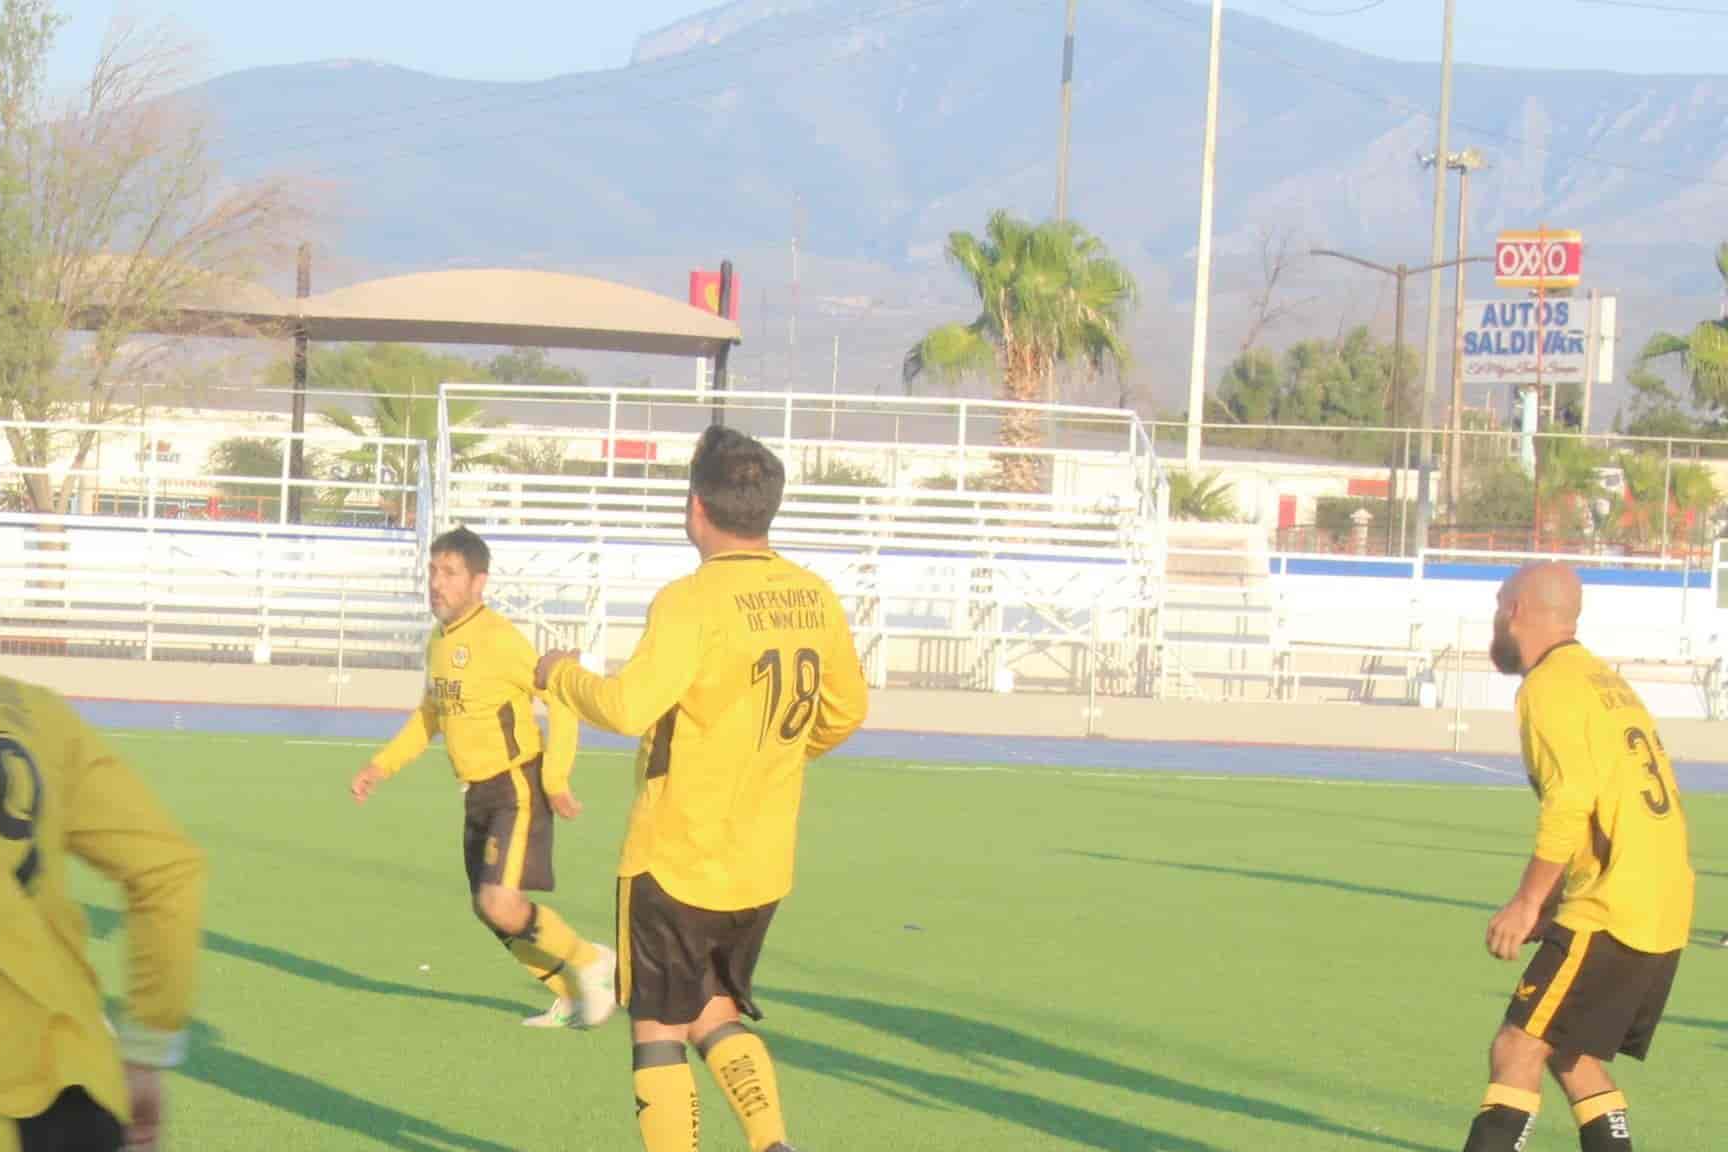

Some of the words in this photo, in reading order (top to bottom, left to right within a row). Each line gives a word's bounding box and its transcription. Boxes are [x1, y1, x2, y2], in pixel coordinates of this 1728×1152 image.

[1498, 243, 1568, 276] OXXO
[1480, 301, 1570, 328] AUTOS
[1463, 329, 1586, 356] SALDIVAR
[751, 647, 821, 752] 18
